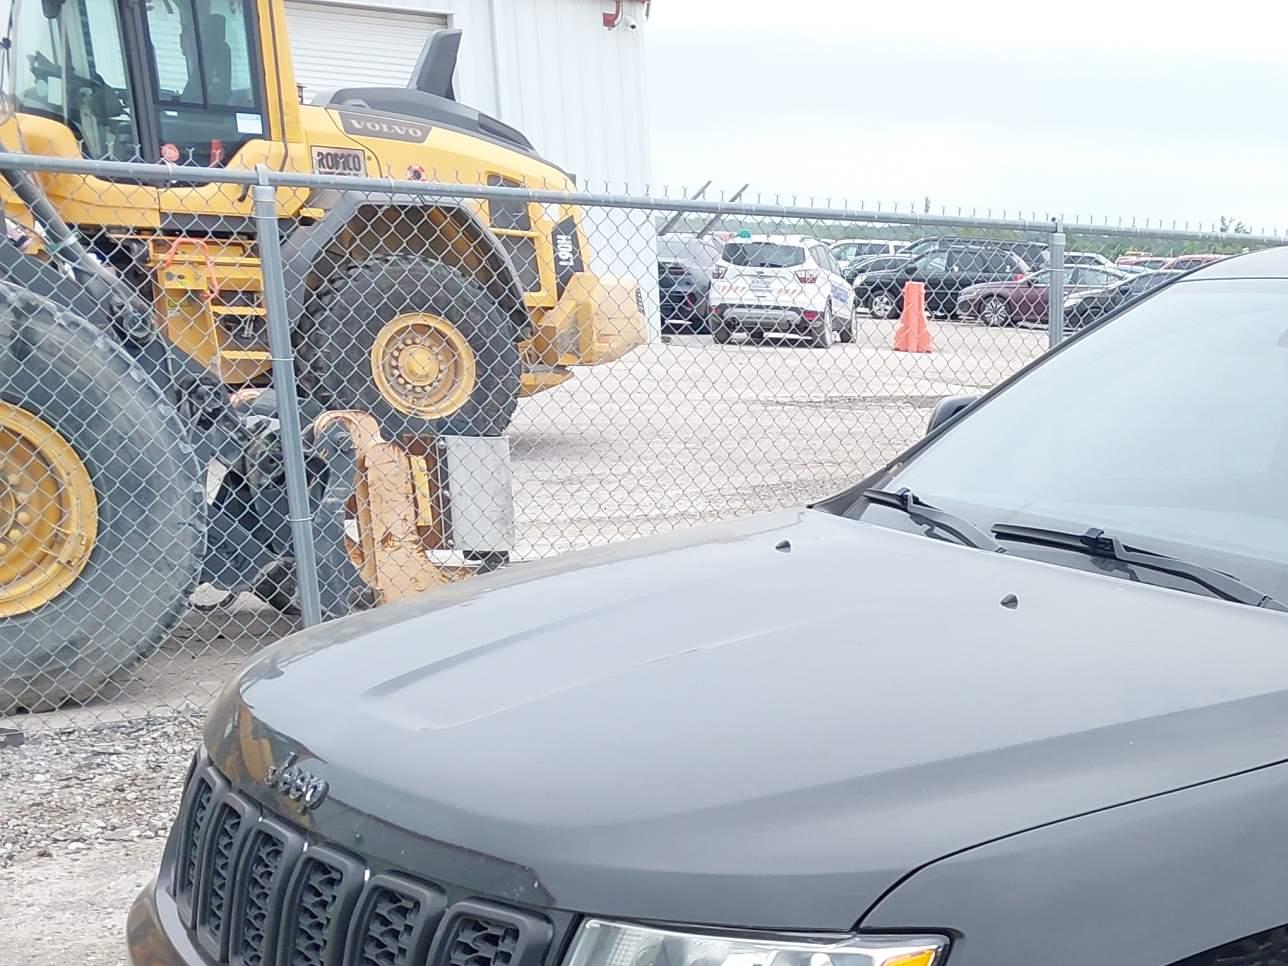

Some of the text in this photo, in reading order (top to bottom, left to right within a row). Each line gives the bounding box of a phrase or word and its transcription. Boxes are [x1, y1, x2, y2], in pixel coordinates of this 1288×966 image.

[350, 119, 422, 138] VOLVO
[317, 151, 362, 172] ROMCO
[556, 234, 575, 266] L90H
